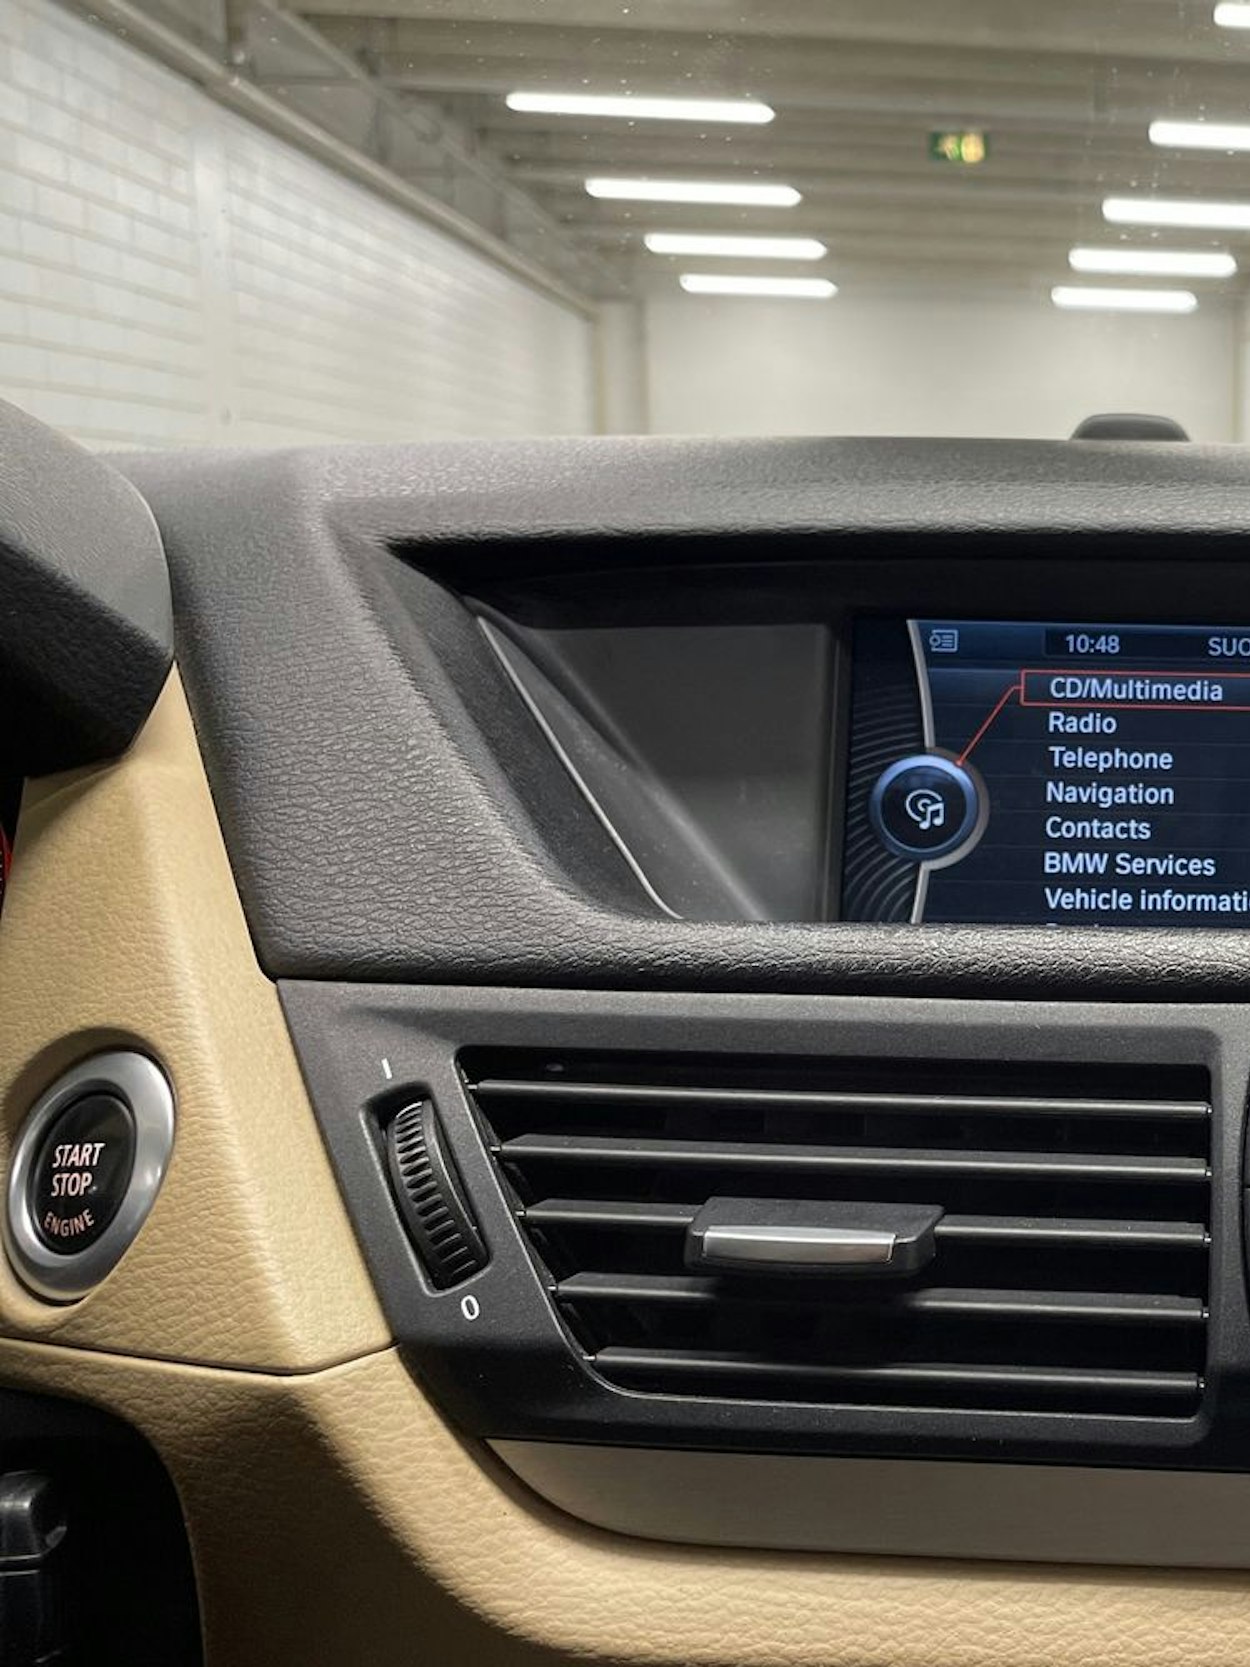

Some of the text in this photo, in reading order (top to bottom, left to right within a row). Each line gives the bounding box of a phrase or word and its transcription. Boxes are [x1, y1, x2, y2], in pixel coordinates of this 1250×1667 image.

[1066, 634, 1120, 653] 10:48
[1049, 677, 1223, 702] CD/Multimedia
[1048, 712, 1117, 734] Radio
[1050, 747, 1173, 773] Telephone
[1046, 782, 1174, 808] Navigation
[1045, 817, 1151, 841] Contacts
[1044, 853, 1216, 878] BMW Services
[1044, 887, 1133, 910] Vehicle
[52, 1142, 106, 1167] START
[51, 1172, 92, 1197] STOP
[43, 1207, 96, 1238] ENGINE
